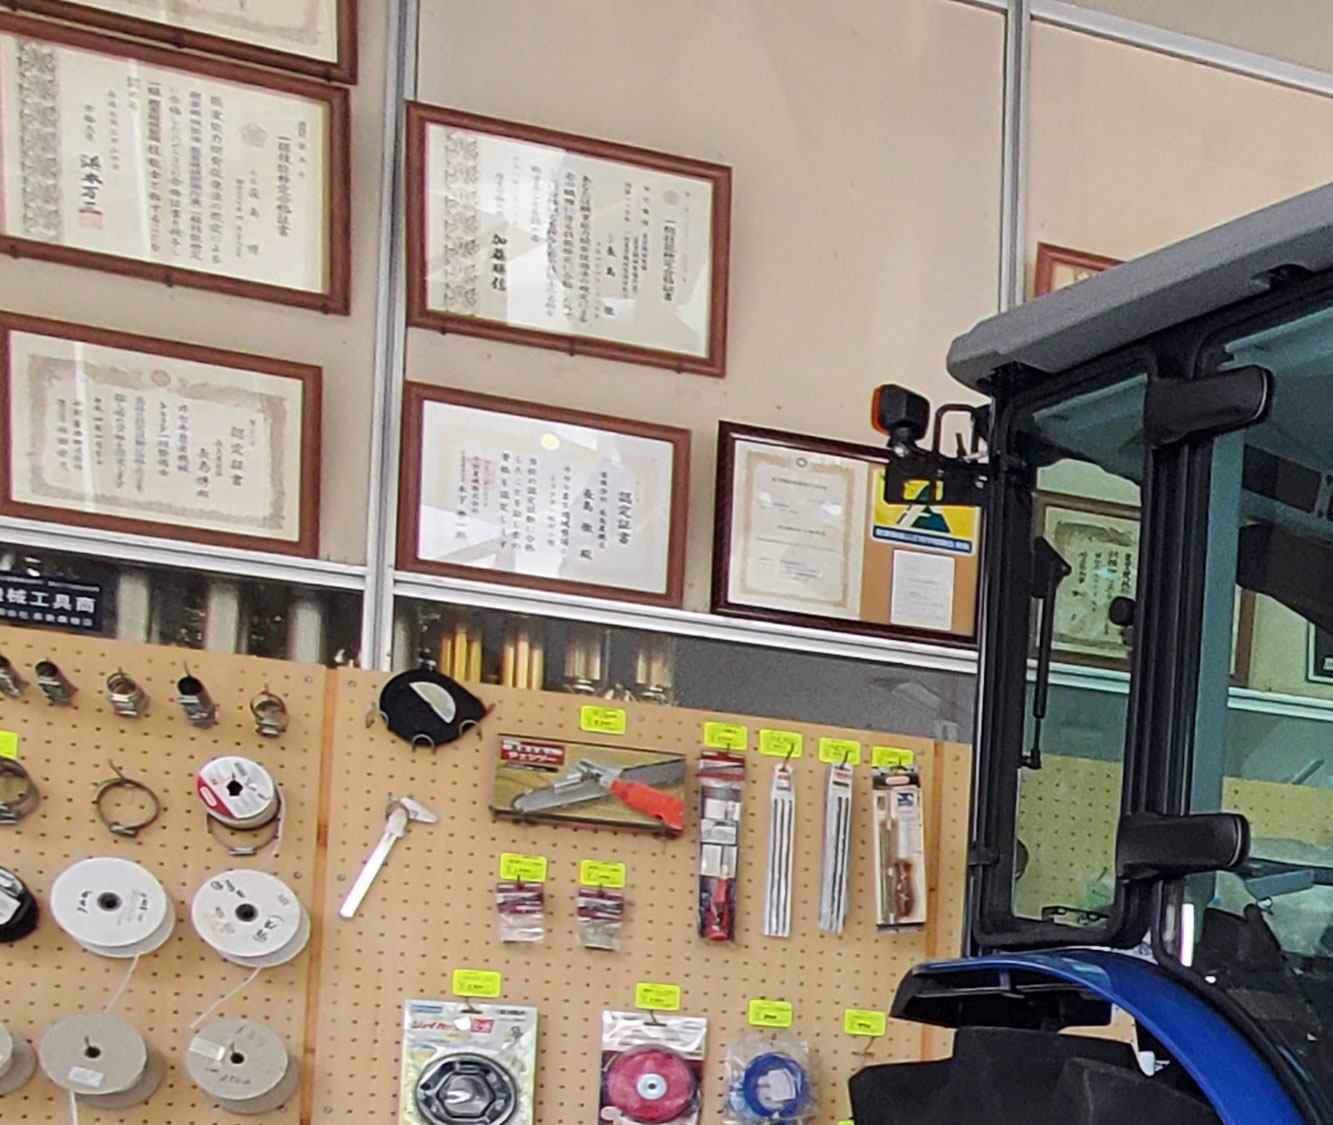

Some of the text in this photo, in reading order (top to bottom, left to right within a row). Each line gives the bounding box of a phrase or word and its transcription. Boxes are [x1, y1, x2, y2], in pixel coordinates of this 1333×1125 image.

[617, 491, 633, 545] 認定証書
[0, 587, 97, 614] 械工具商
